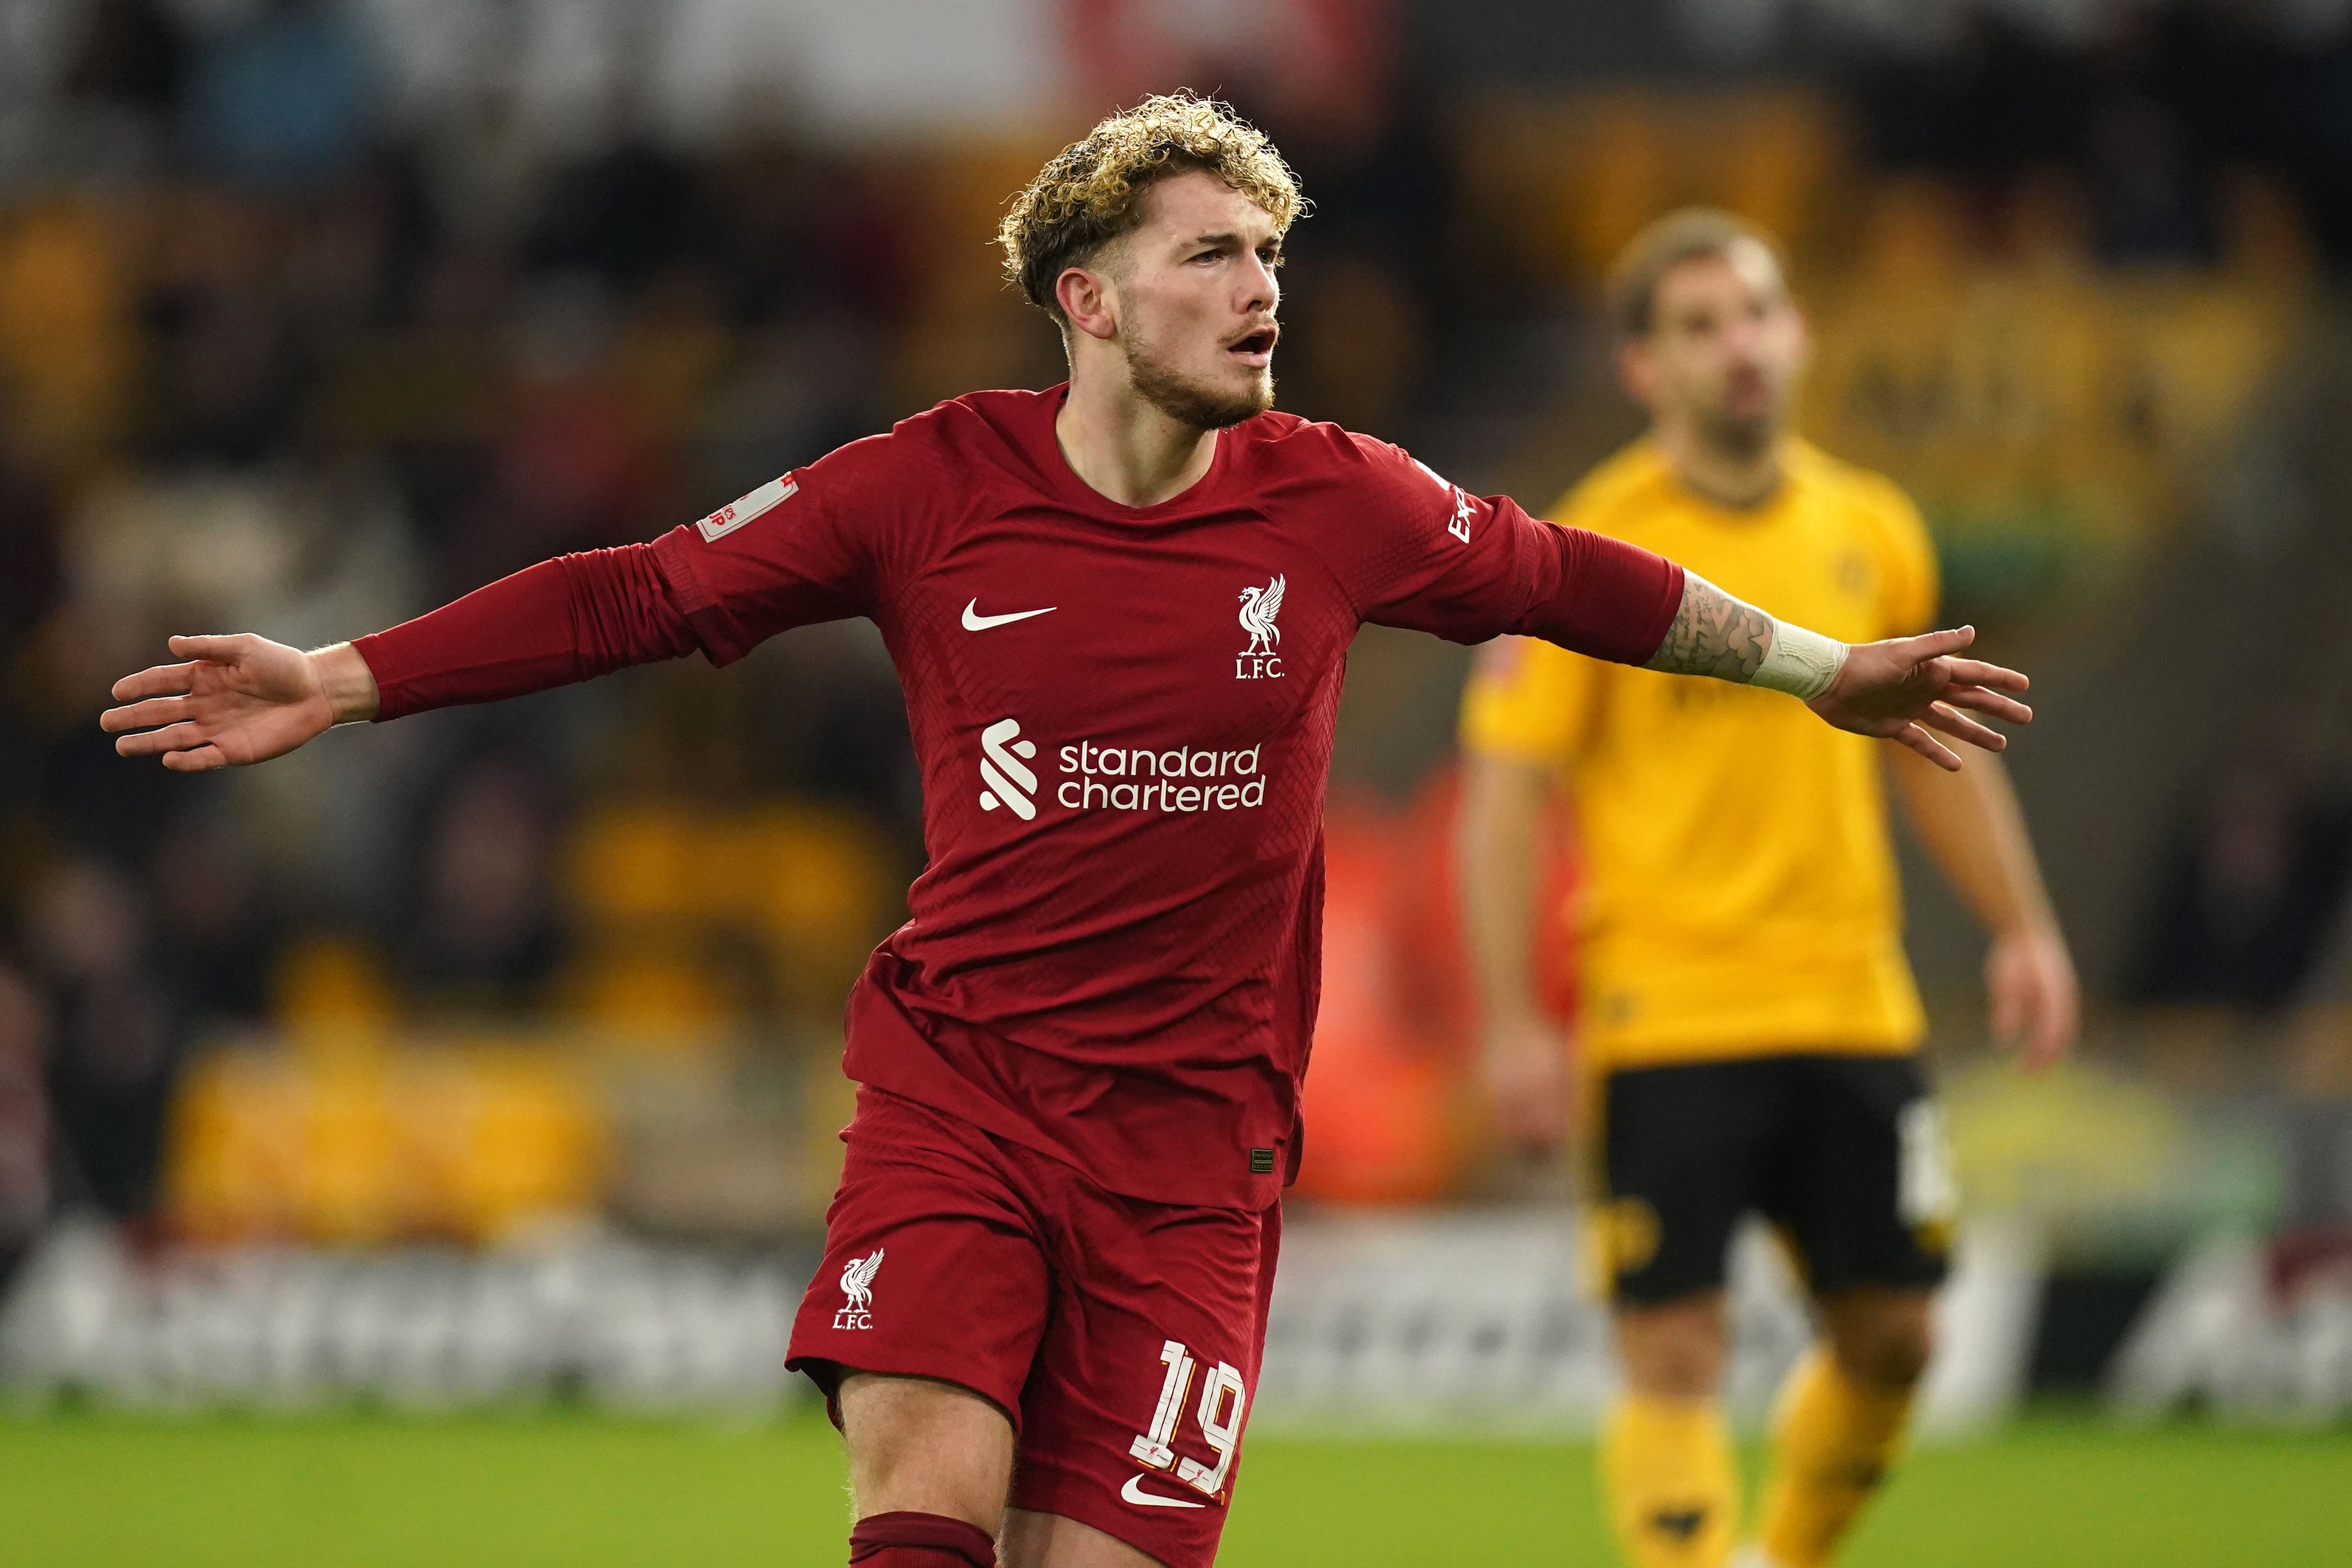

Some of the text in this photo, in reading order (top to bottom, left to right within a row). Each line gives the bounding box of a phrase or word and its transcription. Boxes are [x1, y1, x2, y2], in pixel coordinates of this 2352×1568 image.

[1235, 658, 1285, 679] L.F.C.
[1059, 740, 1261, 778] standard
[1057, 774, 1266, 812] chartered
[832, 1314, 873, 1329] L.F.C.
[1128, 1339, 1247, 1498] 19
